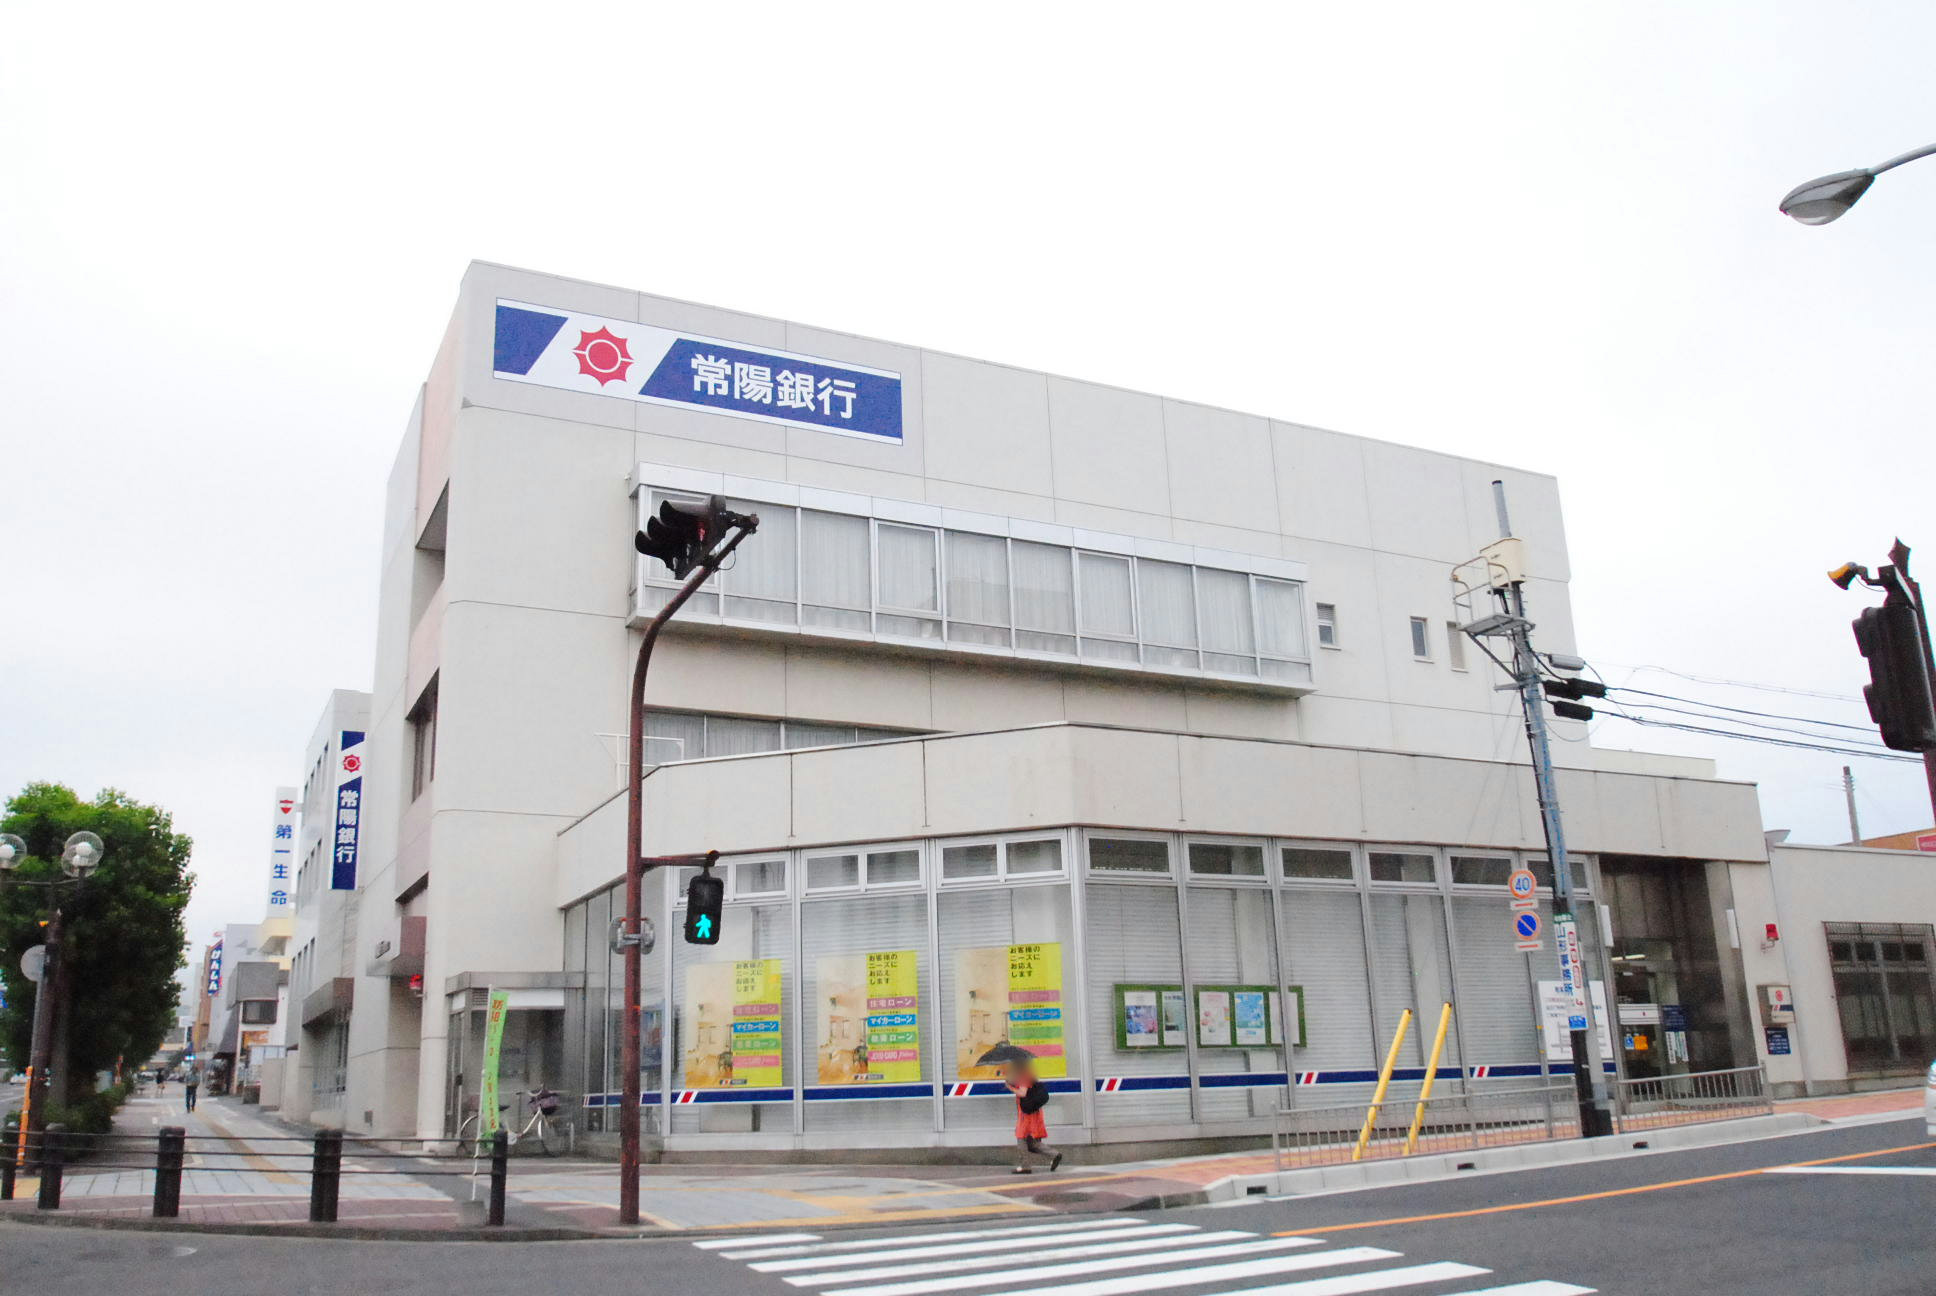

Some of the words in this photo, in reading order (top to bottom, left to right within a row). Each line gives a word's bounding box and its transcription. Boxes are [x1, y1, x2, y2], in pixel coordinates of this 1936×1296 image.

[690, 351, 857, 420] 常陽銀行
[335, 789, 359, 864] 常陽銀行
[270, 823, 293, 905] 第一生命
[1514, 877, 1530, 891] 40
[1010, 946, 1040, 954] お客様の
[868, 953, 898, 961] お客様の
[1010, 954, 1040, 962] ニーズに
[868, 961, 898, 969] ニーズに
[1011, 970, 1033, 978] します
[869, 977, 891, 985] します
[869, 1015, 914, 1025] マイカーローン
